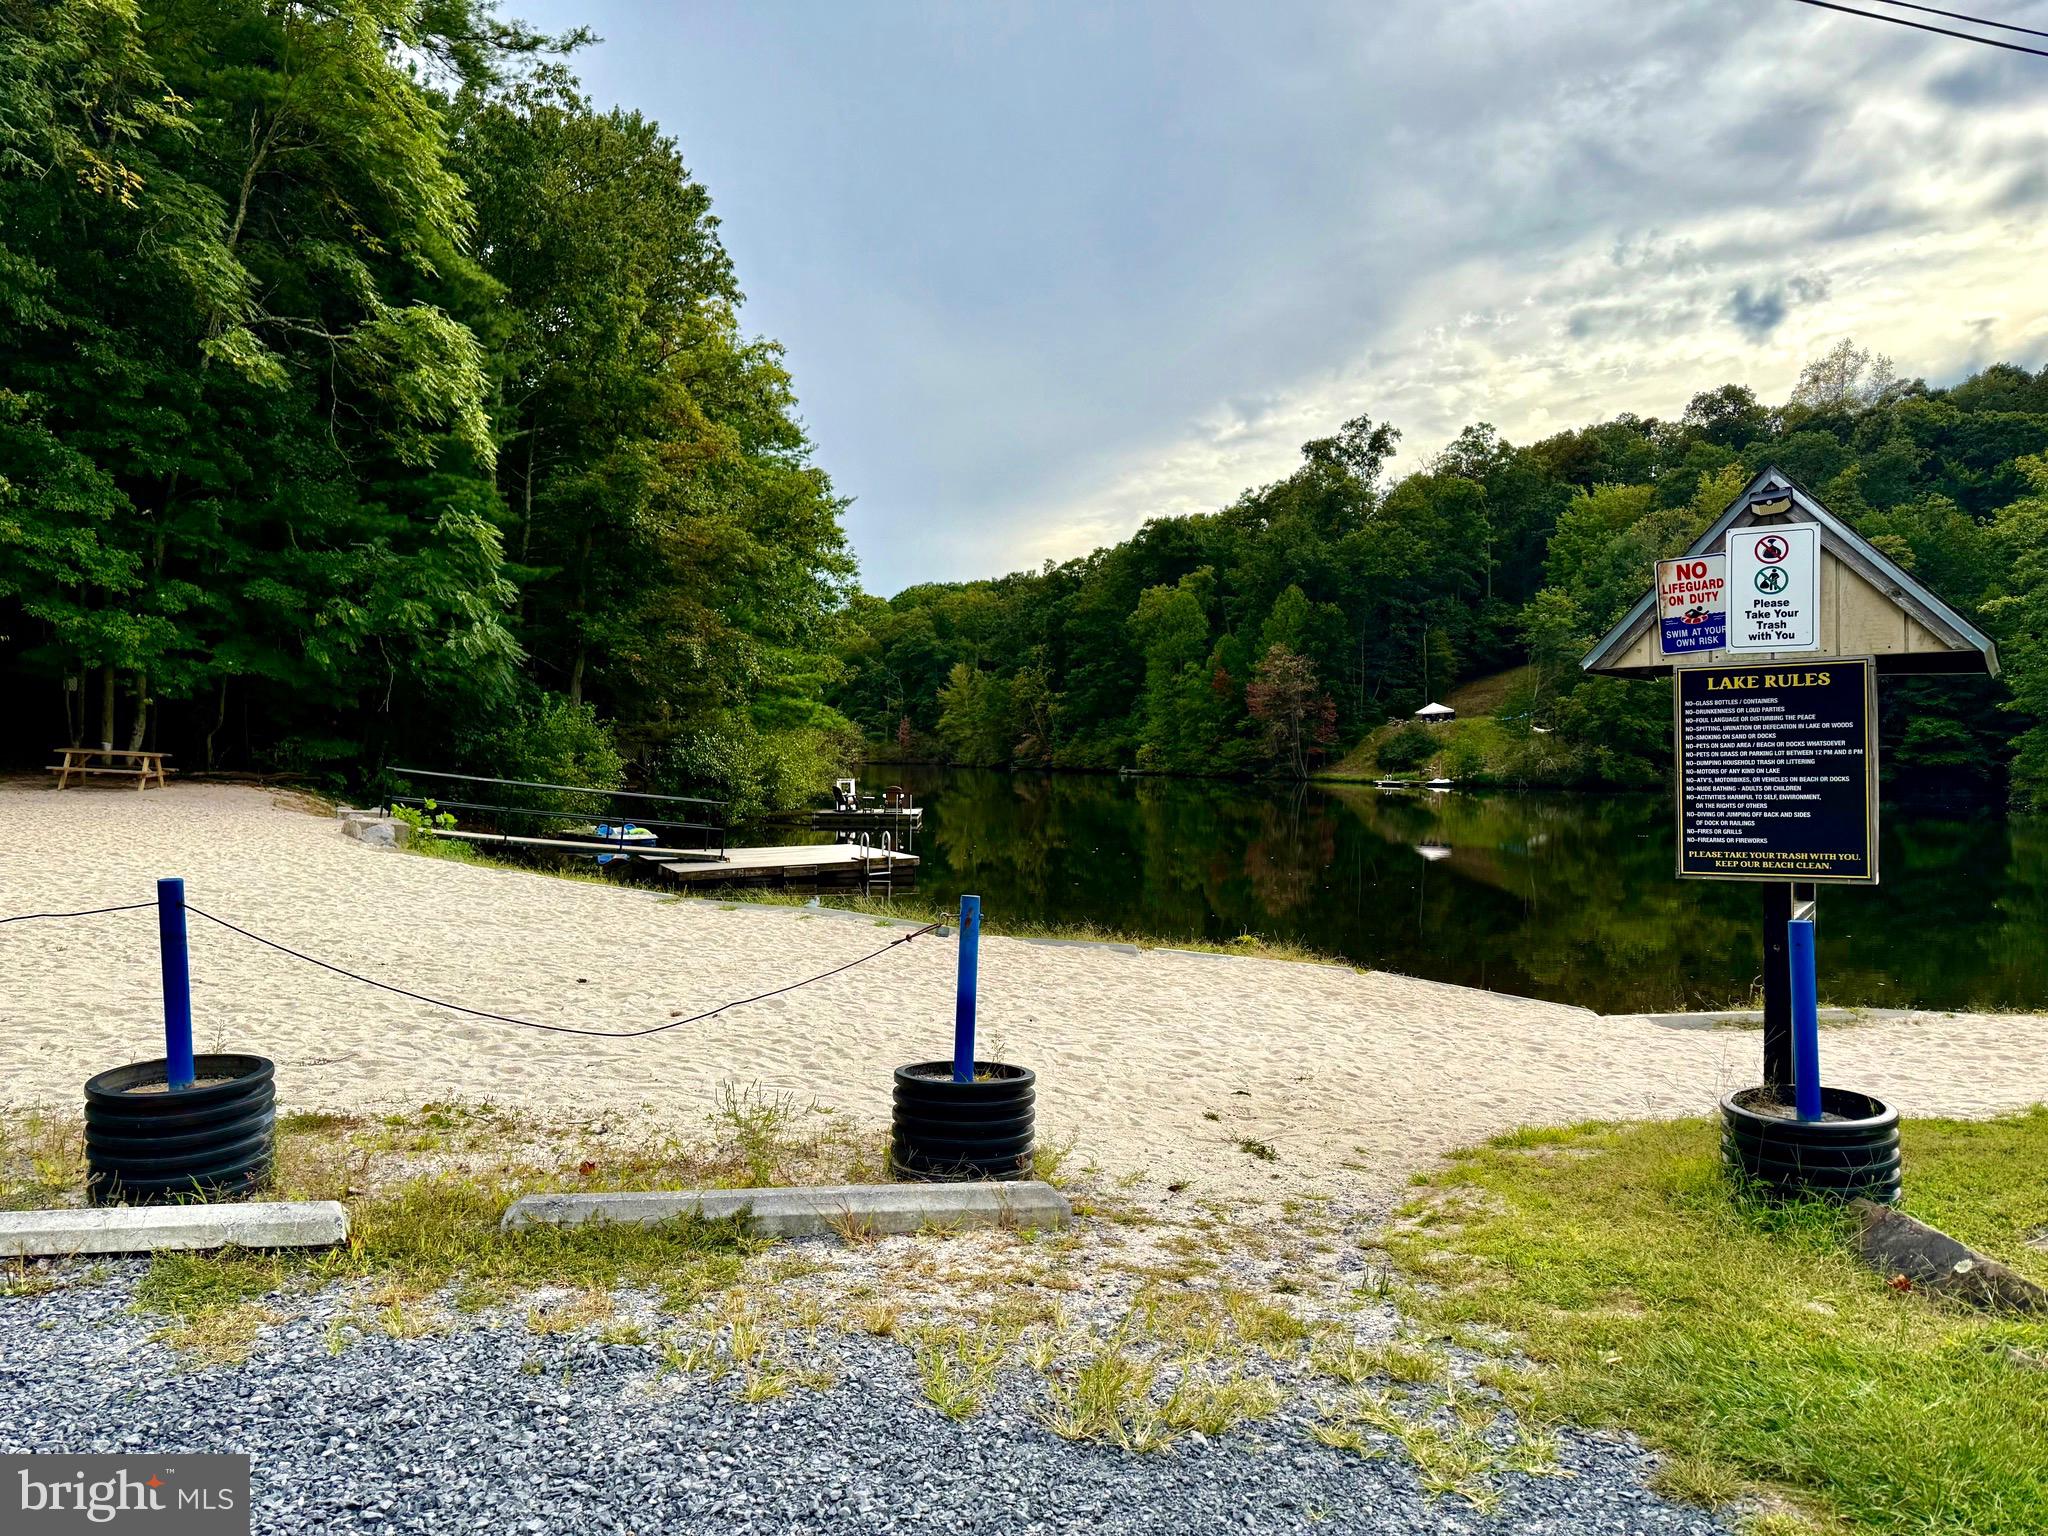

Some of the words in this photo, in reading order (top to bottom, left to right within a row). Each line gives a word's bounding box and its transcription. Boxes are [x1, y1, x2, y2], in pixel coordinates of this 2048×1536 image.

[1676, 562, 1707, 581] NO
[1662, 578, 1724, 594] LIFEGUARD
[1669, 595, 1684, 606] ON
[1690, 591, 1718, 604] DUTY
[1753, 600, 1790, 608] Please
[1745, 611, 1771, 619] Take
[1775, 609, 1799, 618] Your
[1757, 621, 1786, 630] Trash
[1666, 628, 1688, 638] SWIM
[1692, 627, 1702, 636] AT
[1748, 632, 1771, 640] with
[1775, 631, 1795, 640] You
[1676, 638, 1696, 647] OWN
[1699, 636, 1718, 644] RISK
[1708, 676, 1758, 690] LAKE
[1765, 672, 1831, 688] RULES
